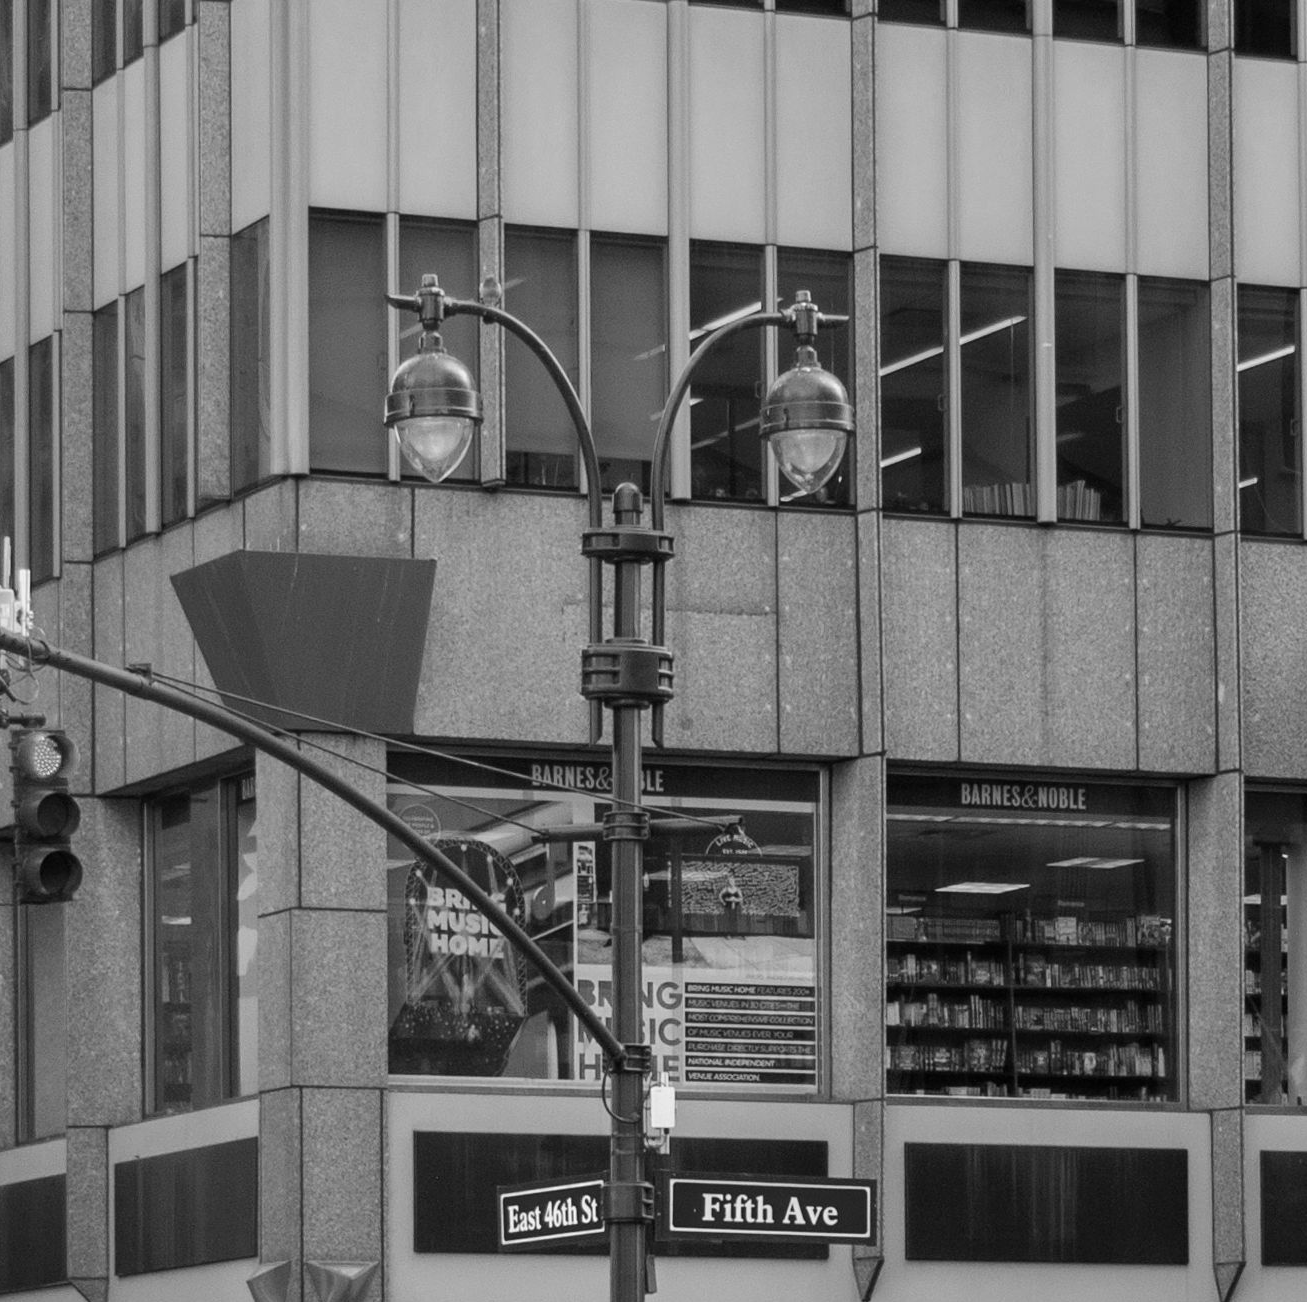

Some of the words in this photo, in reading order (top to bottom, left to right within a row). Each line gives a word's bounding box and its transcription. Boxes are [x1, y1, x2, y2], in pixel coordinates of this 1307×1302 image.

[532, 764, 664, 792] BARNES&LE
[961, 783, 1086, 810] BARNES&NOBLE
[431, 933, 504, 959] HOME
[508, 1203, 542, 1233] East
[544, 1196, 579, 1228] 46th
[580, 1193, 599, 1223] St
[702, 1192, 774, 1224] Fifth
[782, 1197, 839, 1225] Ave
